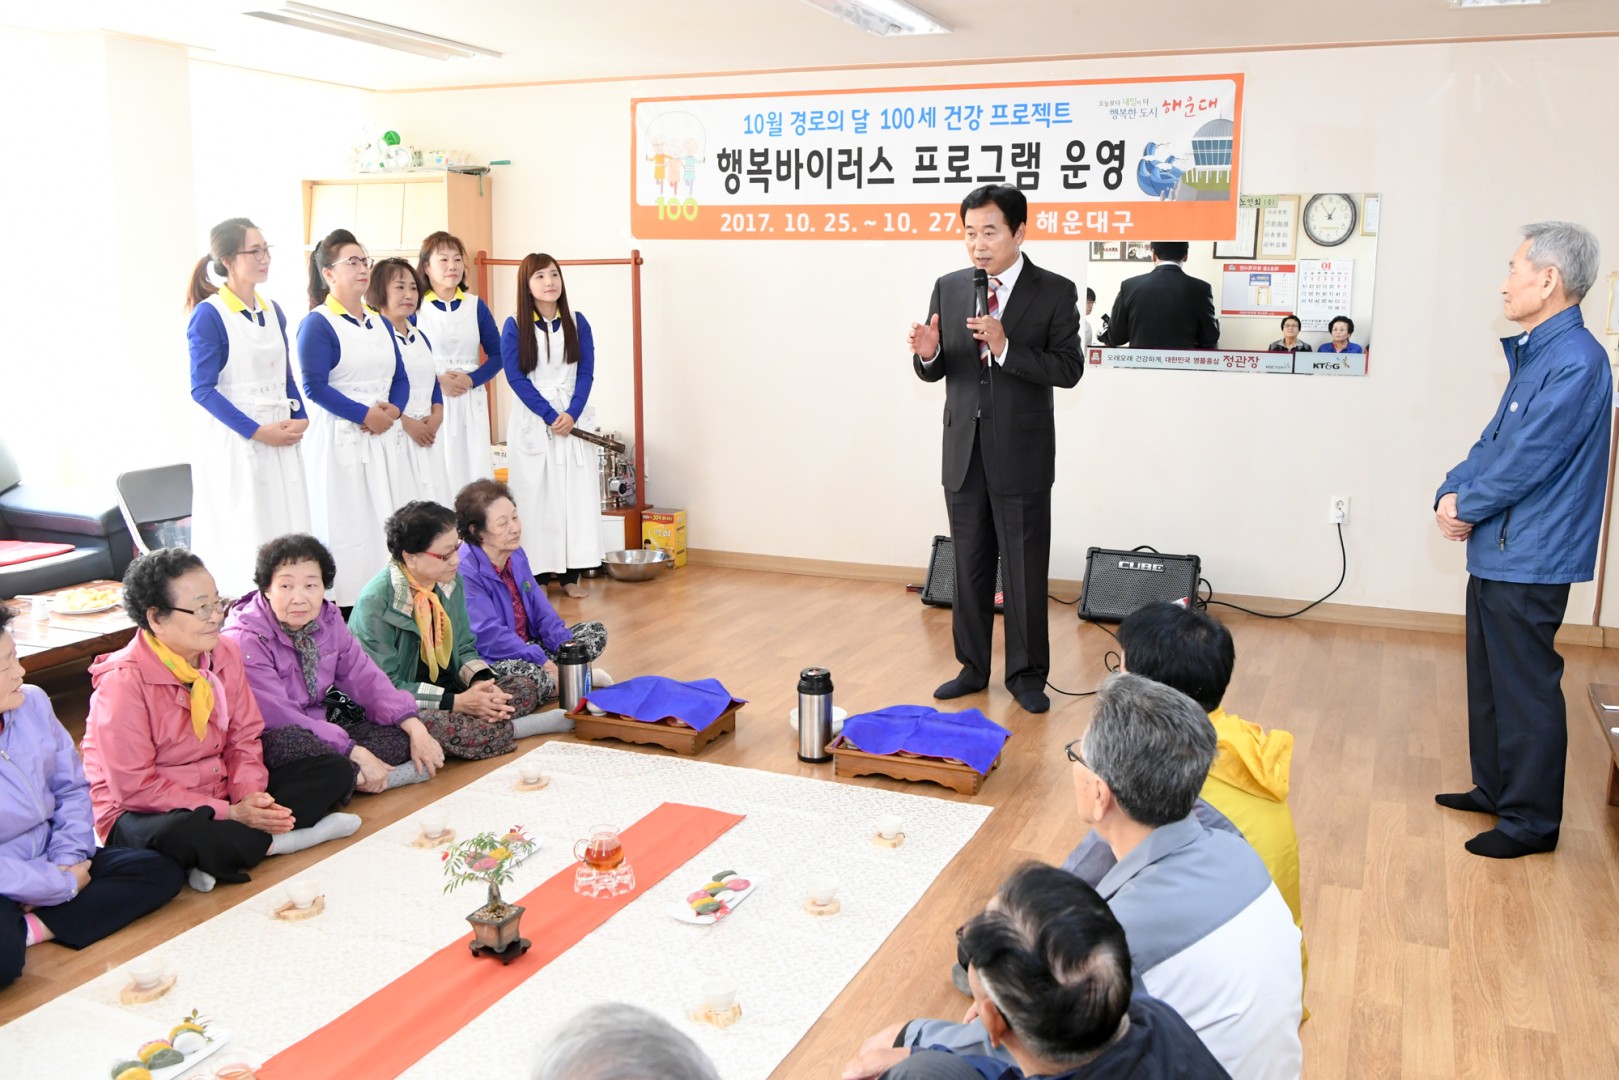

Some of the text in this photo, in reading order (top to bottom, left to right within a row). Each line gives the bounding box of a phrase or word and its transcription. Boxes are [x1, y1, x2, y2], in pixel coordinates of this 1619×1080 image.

[1109, 106, 1158, 120] 행복한 도시
[1161, 95, 1218, 118] 해운대
[743, 111, 783, 137] 10월
[790, 109, 844, 136] 경로의
[851, 108, 870, 134] 달
[944, 104, 984, 131] 건강
[989, 102, 1073, 129] 프로젝트
[716, 139, 1126, 196] 행복바이러스 프로그램 운영
[655, 196, 699, 221] 100
[720, 213, 774, 233] 2017.
[785, 213, 816, 233] 10.
[824, 212, 858, 233] 25.
[883, 212, 918, 234] 10.
[928, 212, 962, 234] 27.
[1036, 210, 1134, 235] 해운대구
[1107, 354, 1134, 362] 오래오래
[1165, 356, 1191, 364] 대한민국
[1222, 355, 1260, 369] 정관장
[1312, 362, 1341, 370] KT&G
[1118, 560, 1164, 572] CUBE
